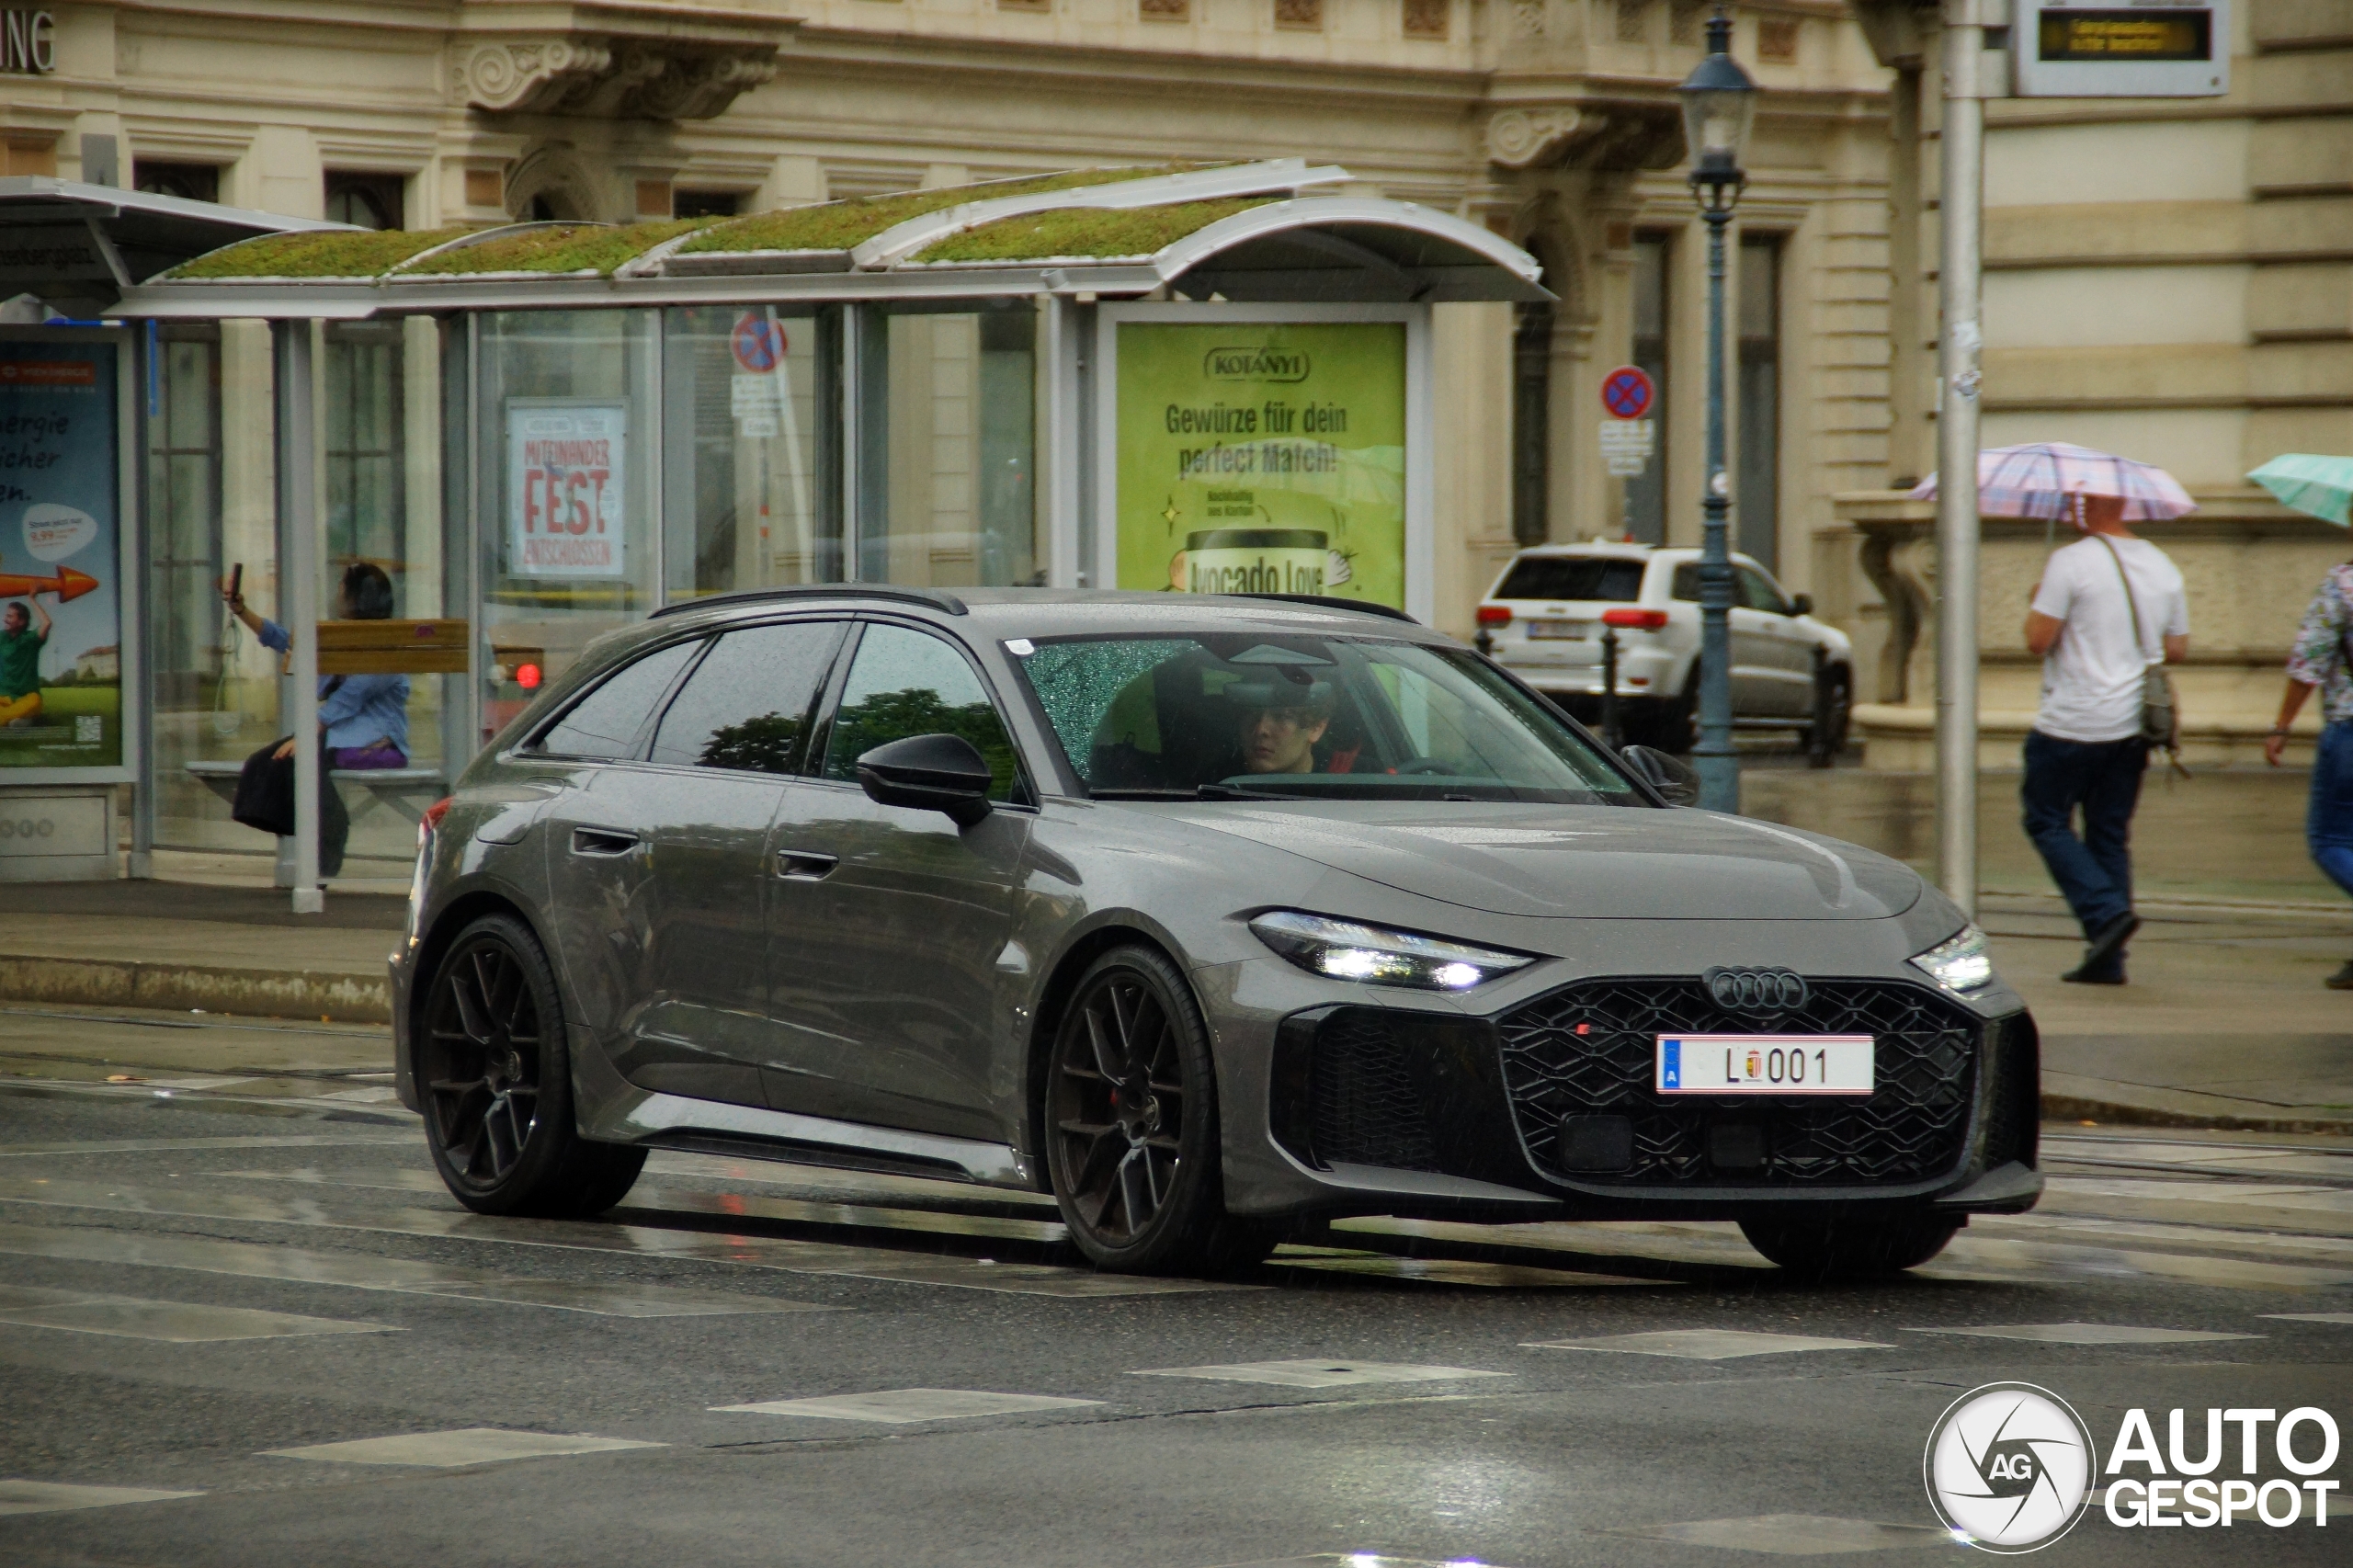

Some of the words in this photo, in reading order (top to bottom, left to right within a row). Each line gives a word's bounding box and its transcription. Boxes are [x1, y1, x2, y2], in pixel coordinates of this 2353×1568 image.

[1166, 402, 1257, 434] Gewürze
[1264, 401, 1296, 433] für
[1302, 402, 1347, 433] dein
[1179, 441, 1255, 481] perfect
[1262, 442, 1337, 473] Match!
[524, 469, 609, 536] FEST
[1191, 556, 1279, 594] Avocado
[1287, 559, 1324, 595] Love
[1666, 1071, 1677, 1082] A
[1727, 1048, 1741, 1083] L
[1768, 1048, 1825, 1083] 001
